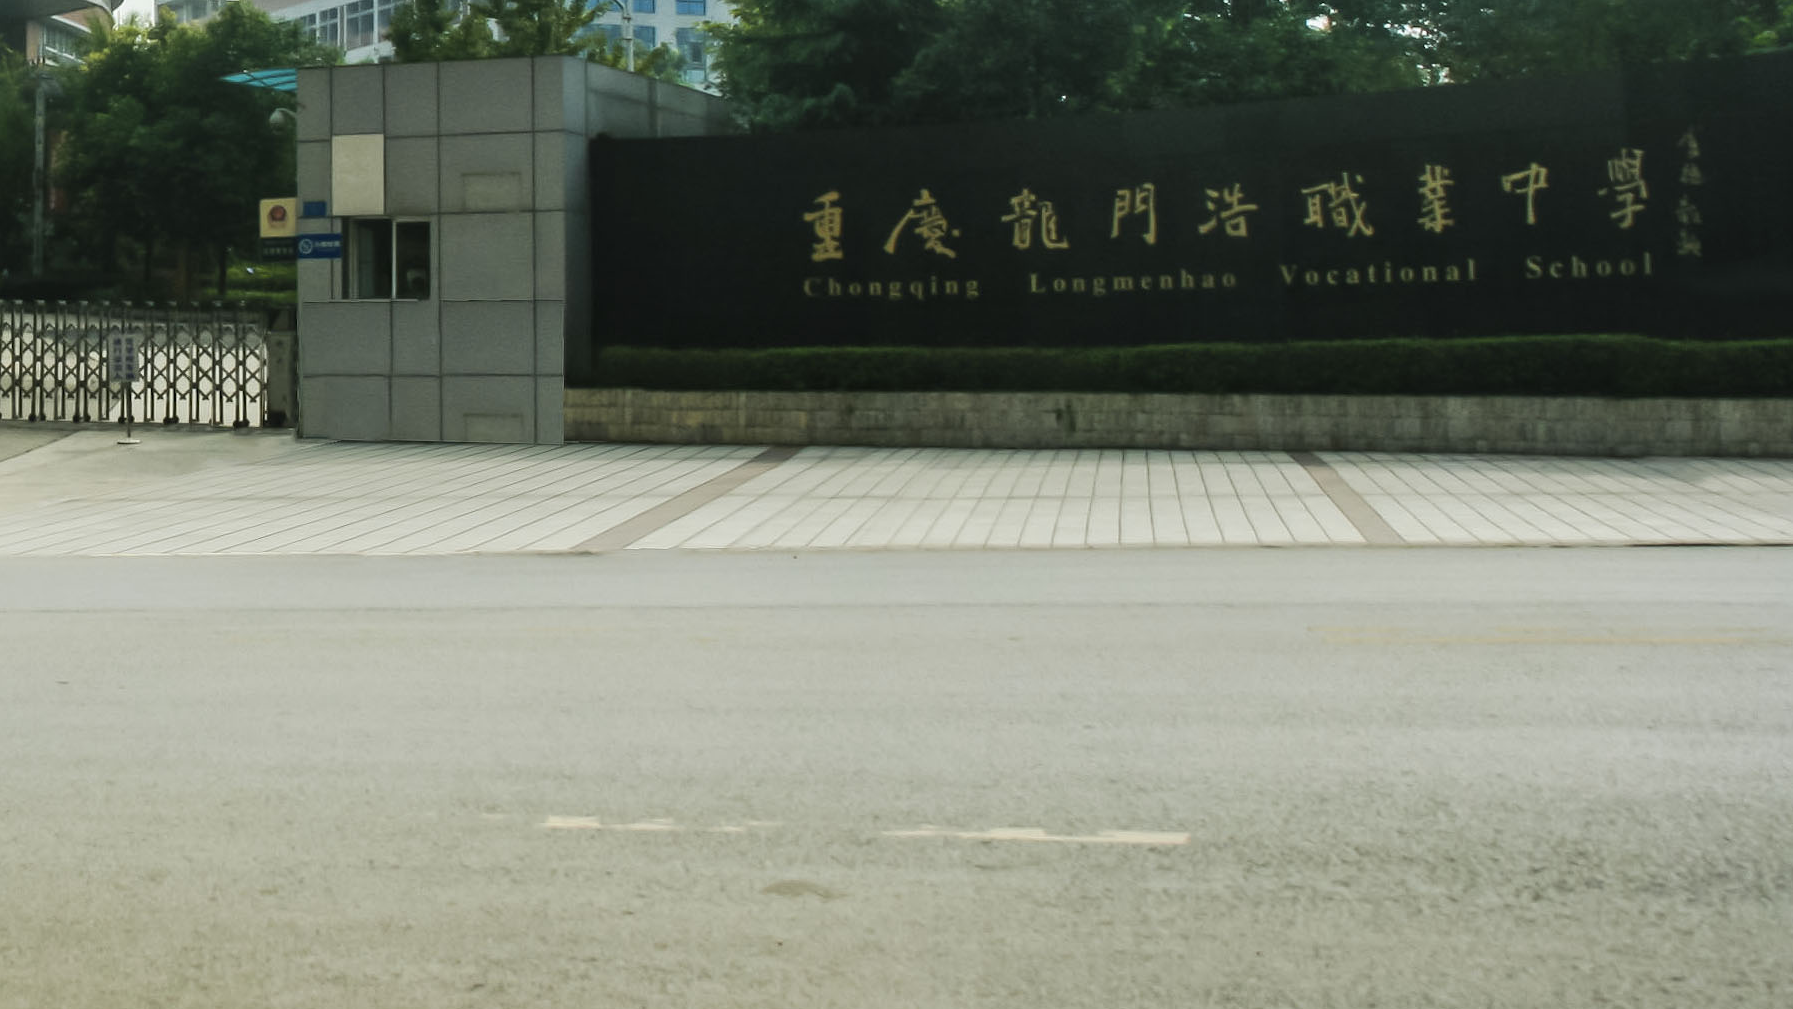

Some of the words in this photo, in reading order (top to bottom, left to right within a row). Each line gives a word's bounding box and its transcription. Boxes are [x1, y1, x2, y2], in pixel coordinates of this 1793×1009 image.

[803, 275, 980, 300] Chongqing
[1029, 267, 1238, 296] Longmenhao
[1278, 257, 1477, 286] Vocational
[1525, 251, 1653, 279] School
